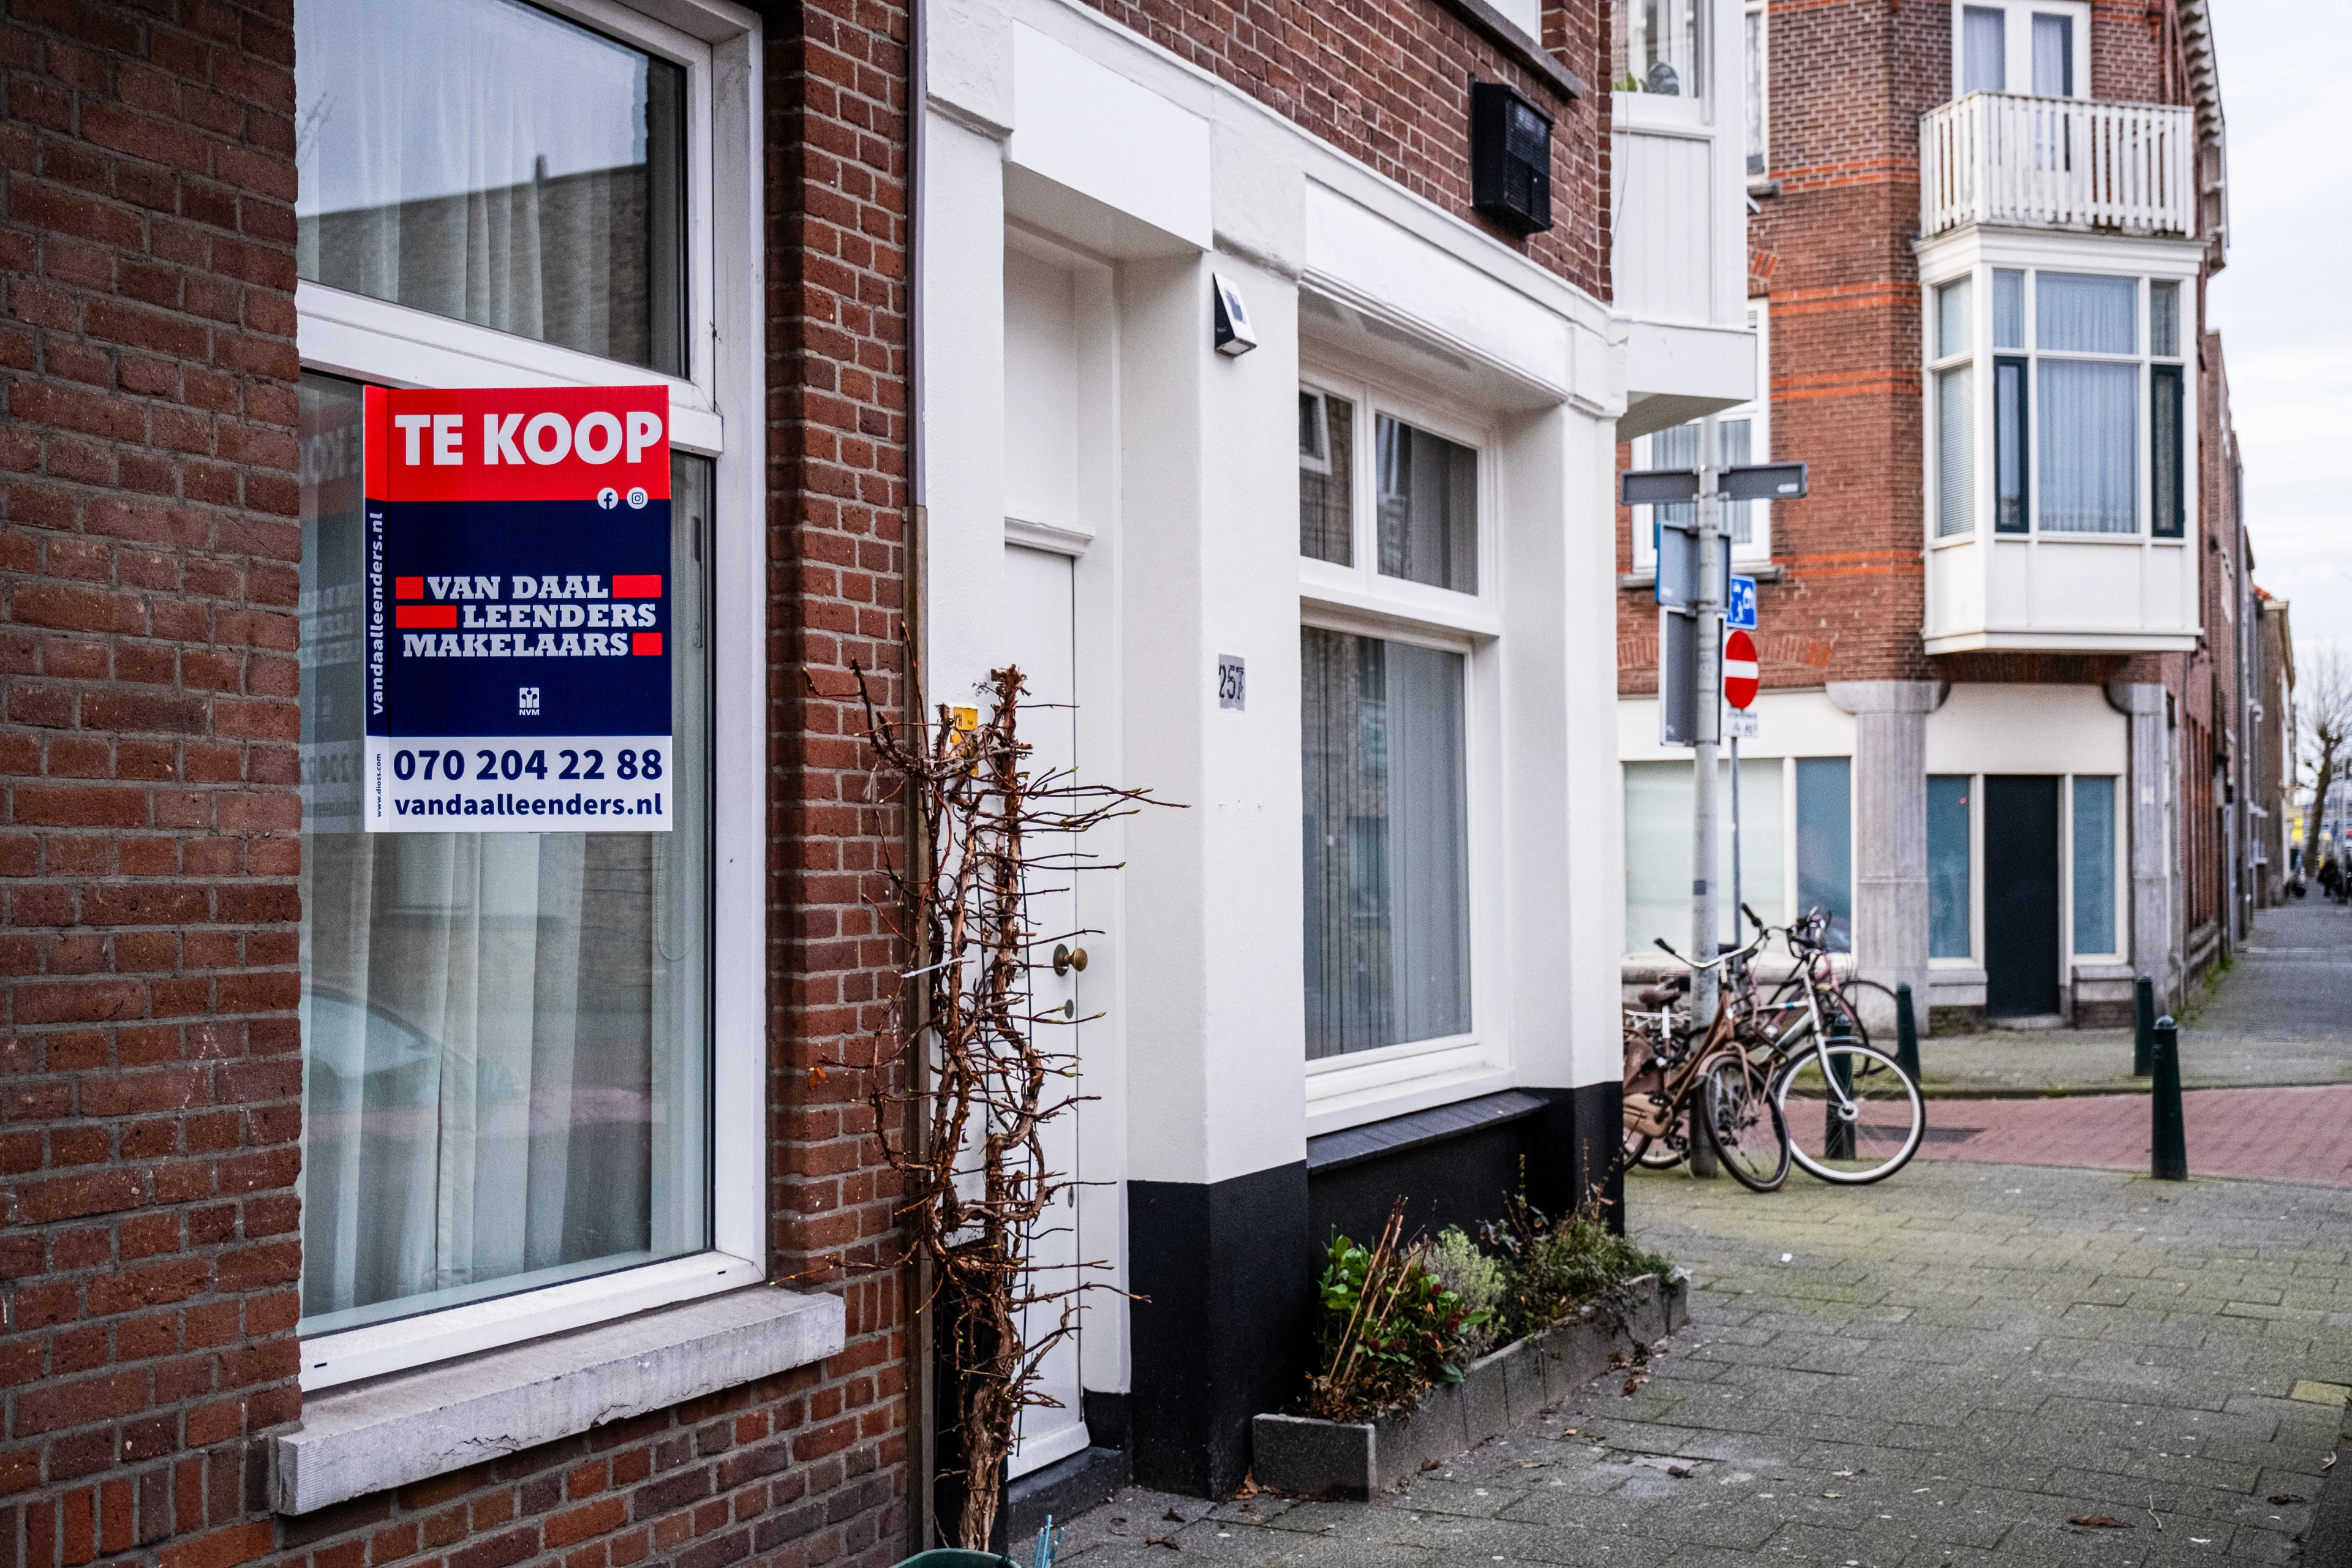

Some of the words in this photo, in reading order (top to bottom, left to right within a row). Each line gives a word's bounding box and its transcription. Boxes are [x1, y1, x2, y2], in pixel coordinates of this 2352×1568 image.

[394, 414, 464, 466] TE
[483, 411, 663, 466] KOOP
[428, 576, 500, 600] VAN
[512, 575, 608, 599] DAAL
[369, 512, 383, 715] vandaalleenders.nl
[463, 603, 656, 628] LEENDERS
[403, 633, 628, 657] MAKELAARS
[1218, 664, 1244, 701] 257
[393, 749, 465, 781] 070
[476, 749, 548, 780] 204
[559, 749, 605, 780] 22
[617, 748, 663, 780] 88
[394, 793, 663, 815] vandaalleenders.nl
